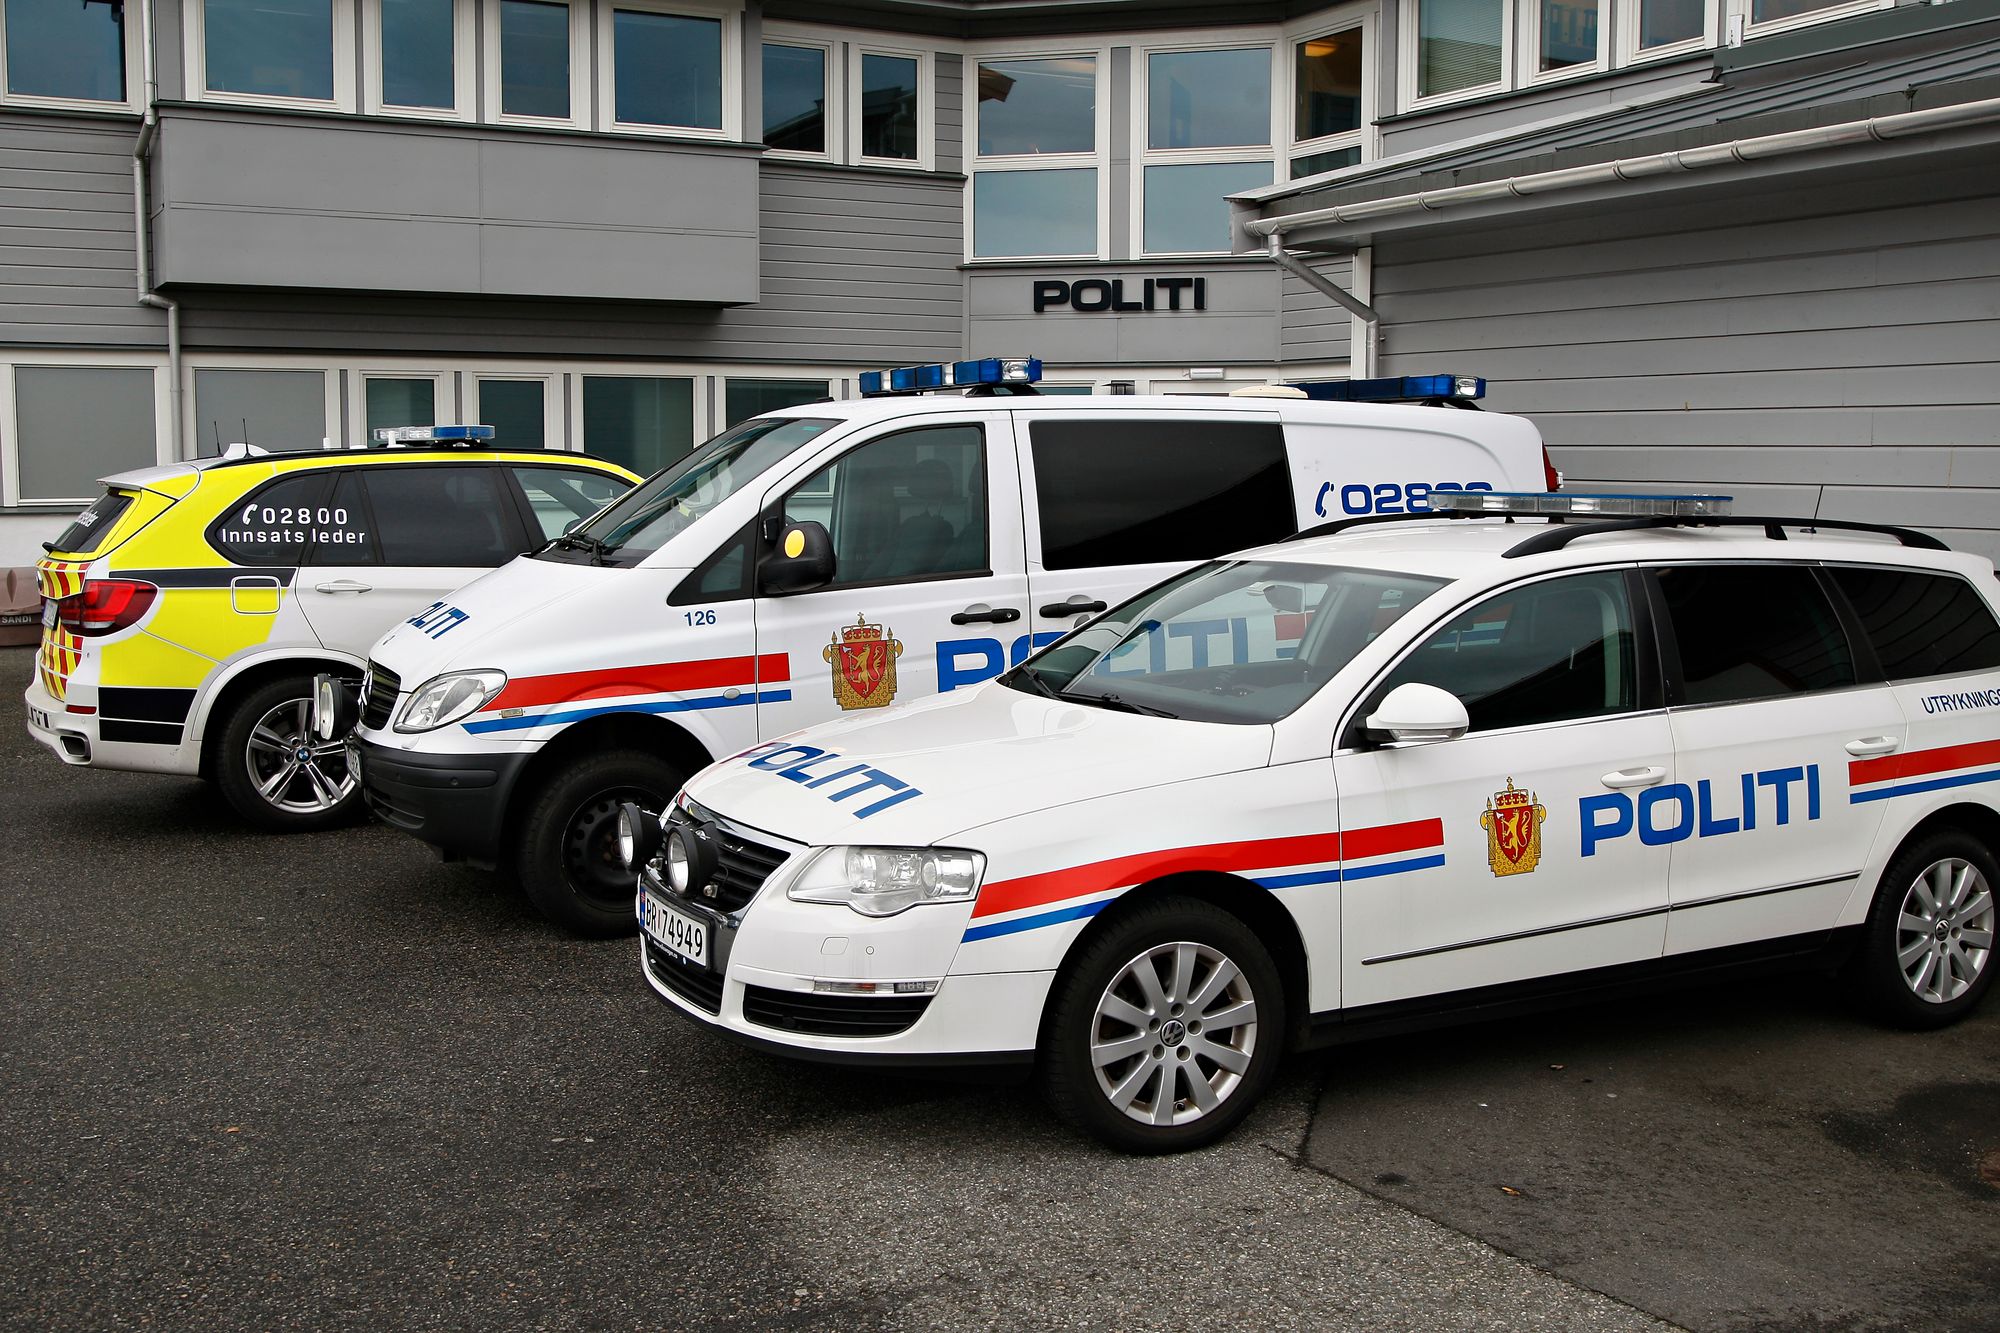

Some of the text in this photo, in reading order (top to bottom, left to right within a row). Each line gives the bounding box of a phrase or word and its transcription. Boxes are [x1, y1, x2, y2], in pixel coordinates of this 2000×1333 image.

[1033, 277, 1206, 313] POLITI
[262, 507, 348, 525] 02800
[222, 528, 366, 544] Innsats leder
[406, 601, 471, 640] LITI
[684, 609, 717, 627] 126
[1578, 763, 1822, 858] POLITI
